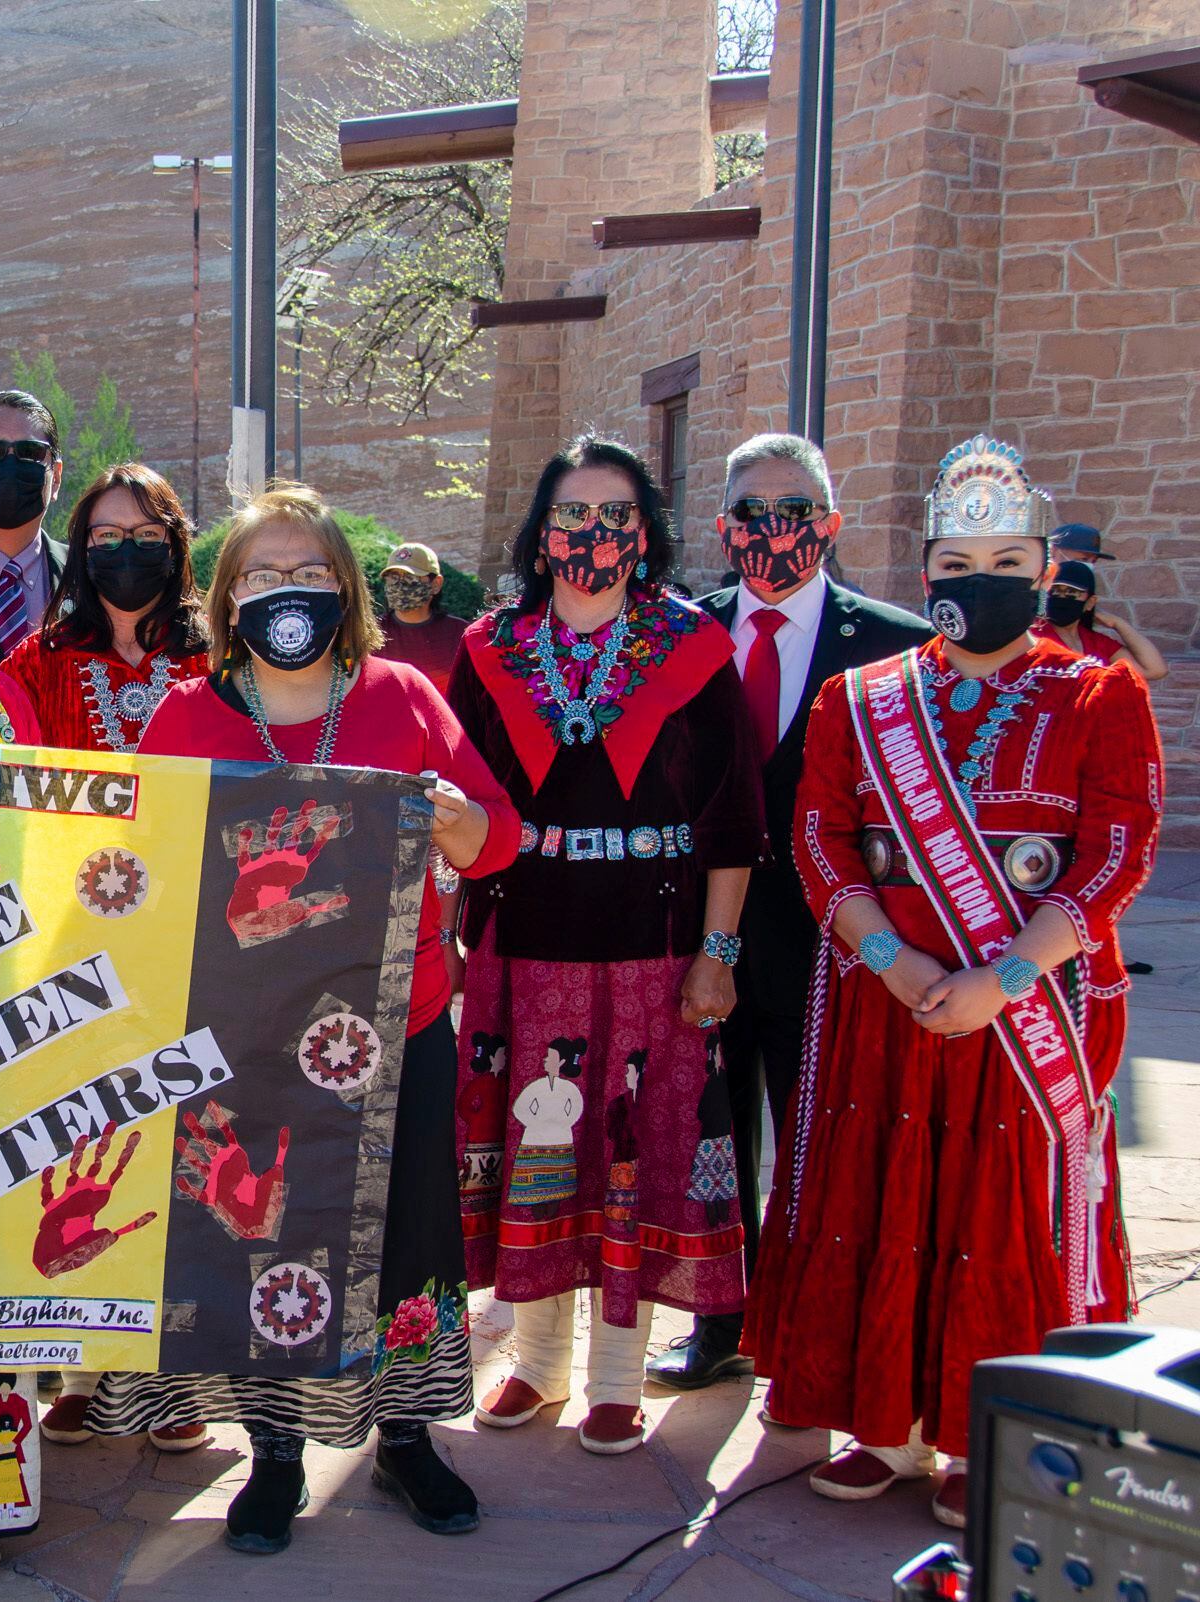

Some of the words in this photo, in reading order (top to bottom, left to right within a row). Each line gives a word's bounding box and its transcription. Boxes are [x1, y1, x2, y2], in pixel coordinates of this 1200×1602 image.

[268, 601, 280, 611] End
[290, 599, 310, 607] Silence
[269, 652, 281, 662] End
[291, 647, 316, 662] Violence
[866, 671, 906, 721] MISS
[877, 722, 943, 822] NAVAJO
[923, 827, 1001, 931] NATION
[100, 1302, 150, 1325] Inc.
[1104, 1466, 1192, 1511] Fender
